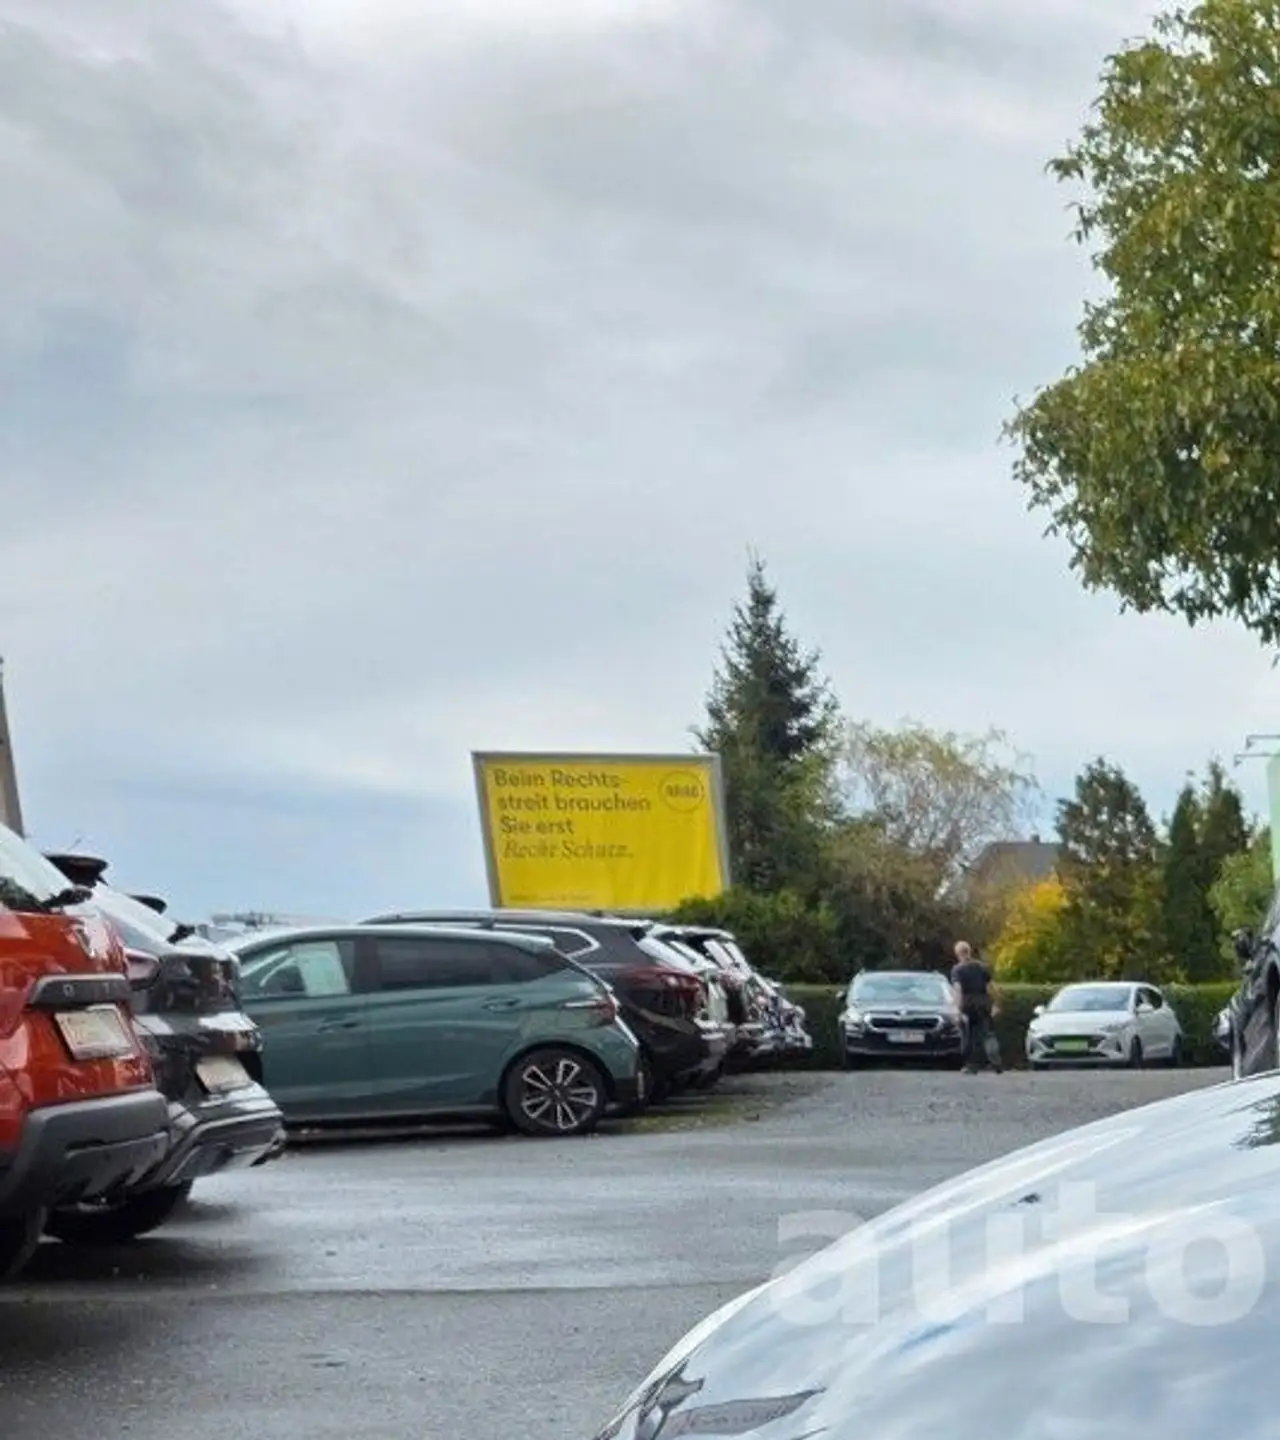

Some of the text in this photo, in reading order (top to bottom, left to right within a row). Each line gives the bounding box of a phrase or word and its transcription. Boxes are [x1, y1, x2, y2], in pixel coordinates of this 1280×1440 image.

[494, 769, 546, 787] Beim
[498, 792, 652, 811] streit brauchen
[501, 814, 575, 834] Sie erst
